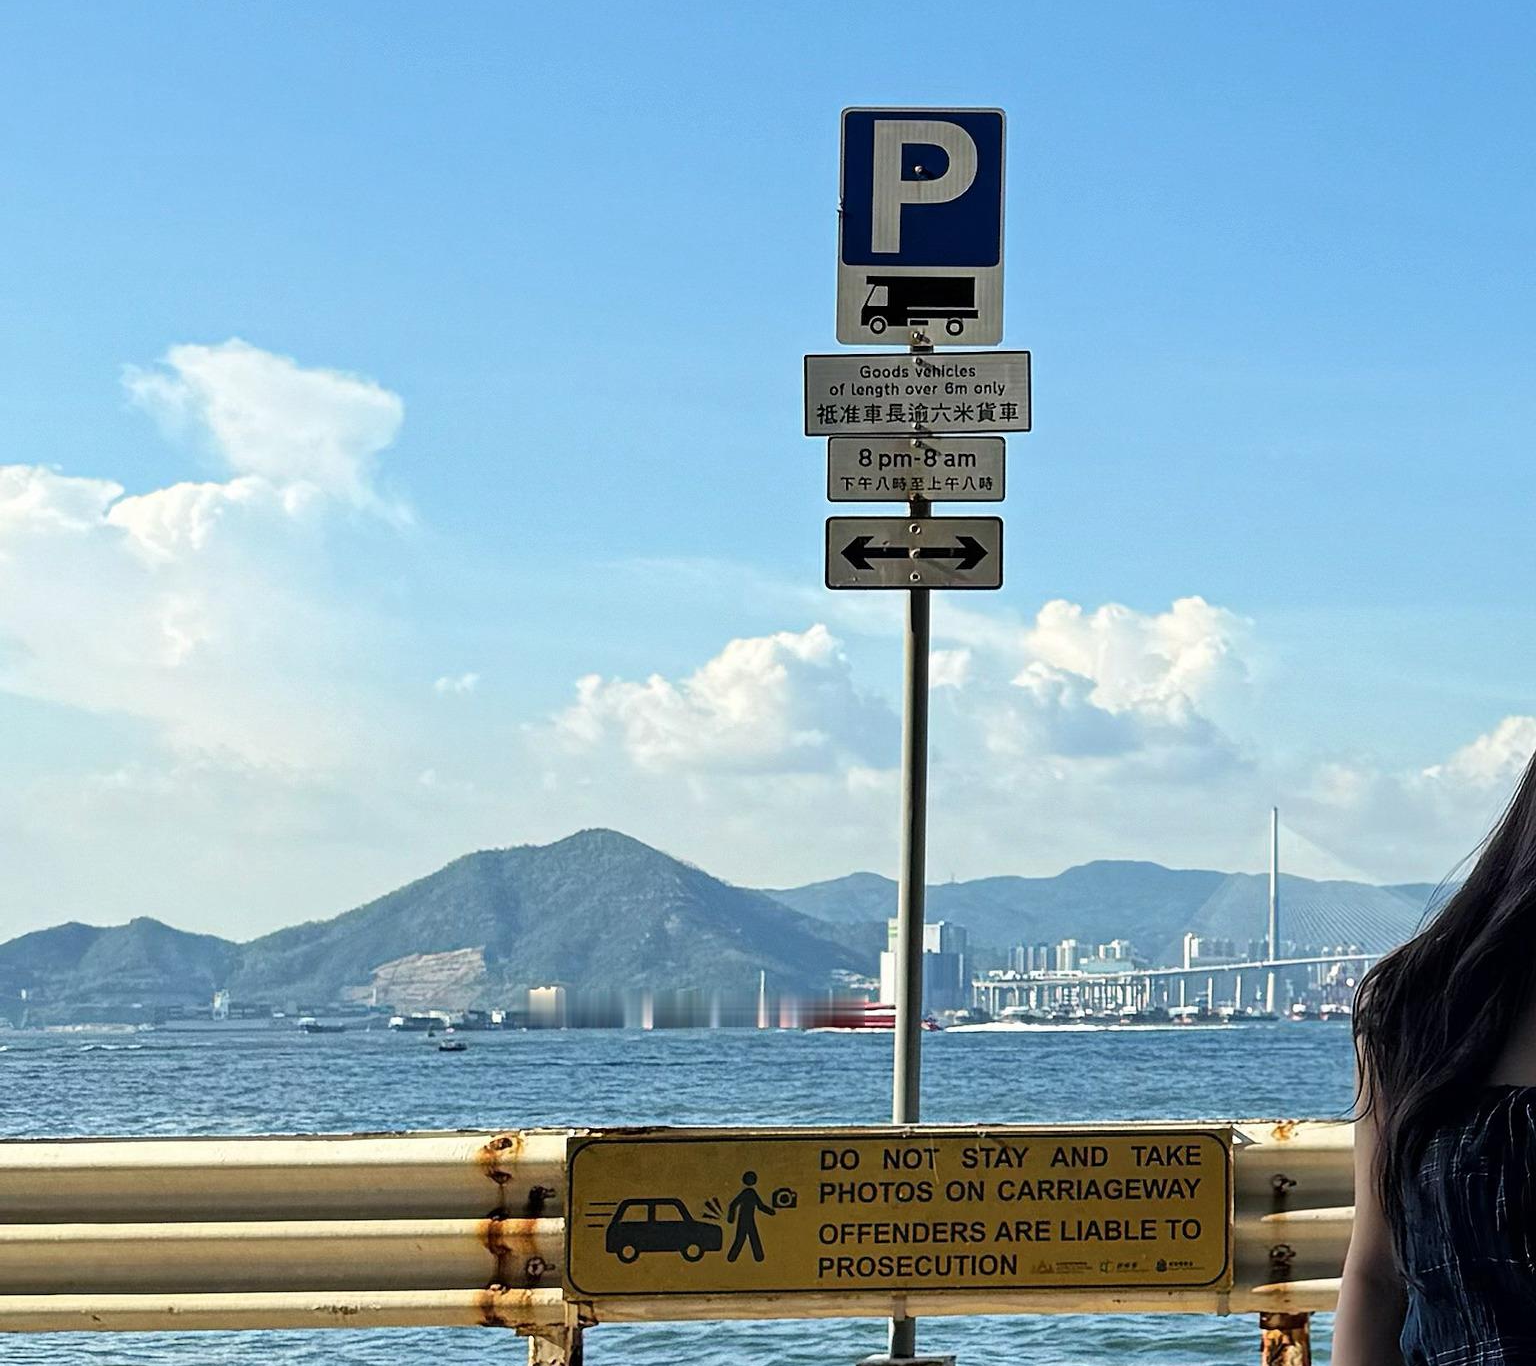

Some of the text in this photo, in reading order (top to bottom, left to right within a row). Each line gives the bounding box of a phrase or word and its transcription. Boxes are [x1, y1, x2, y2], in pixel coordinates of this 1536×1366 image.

[871, 119, 978, 254] P
[860, 365, 976, 379] Goods vehicles
[829, 381, 1005, 398] of length over 6m only
[841, 476, 993, 492] 下午八時至上午八時
[820, 1145, 1202, 1171] DO NOT STAY AND TAKE
[819, 1178, 1202, 1204] PHOTOS ON CARRIAGEWAY
[818, 1218, 1202, 1245] OFFENDERS ARE LIABLE TO
[818, 1254, 1018, 1278] PROSECUTION
